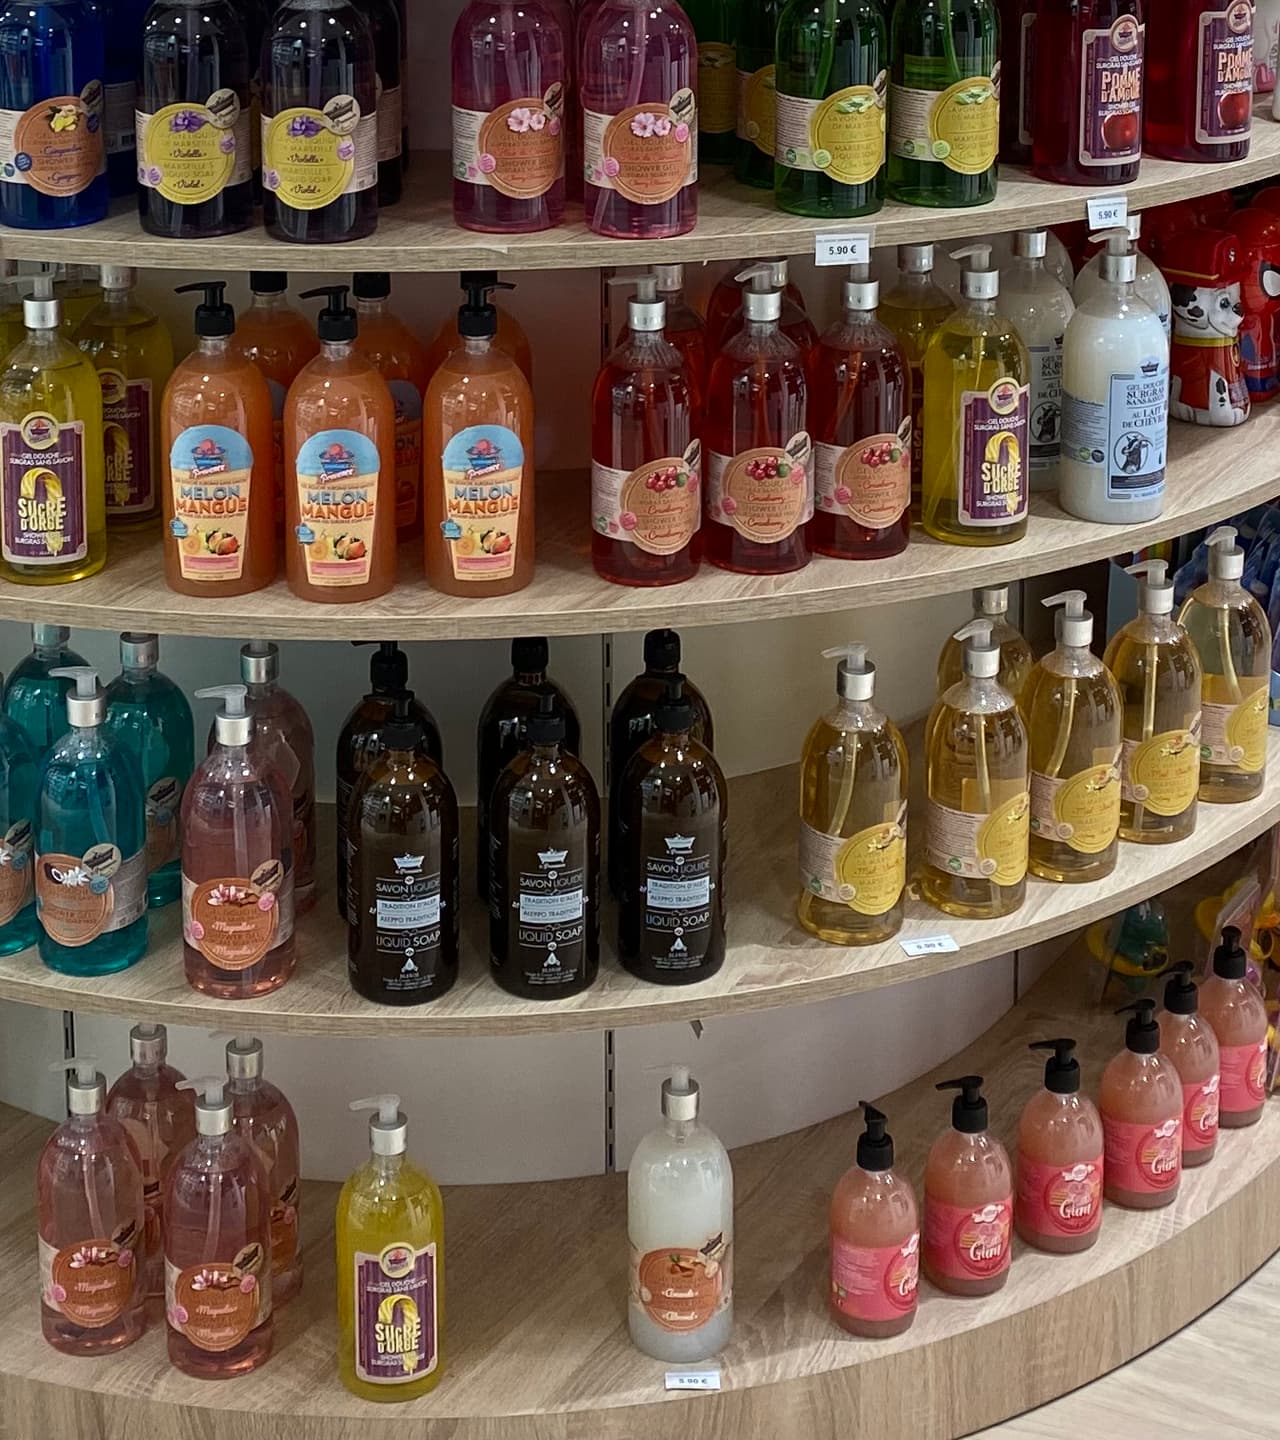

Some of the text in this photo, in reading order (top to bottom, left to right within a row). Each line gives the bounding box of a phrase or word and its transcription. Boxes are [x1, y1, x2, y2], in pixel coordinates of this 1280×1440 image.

[828, 244, 857, 256] 5.90 €
[981, 461, 1021, 482] SUCRE
[181, 484, 240, 500] MELON
[307, 489, 368, 505] MELON
[453, 483, 513, 500] MELON
[18, 496, 66, 519] SUCRE
[175, 497, 247, 515] MANGUE
[302, 502, 374, 521] MANGUE
[448, 496, 519, 515] MANGUE
[647, 861, 679, 873] SAVON
[376, 882, 409, 895] SAVON
[646, 911, 711, 927] LIQUID SOAP
[376, 931, 441, 948] LIQUID SOAP
[556, 925, 583, 941] SOAP
